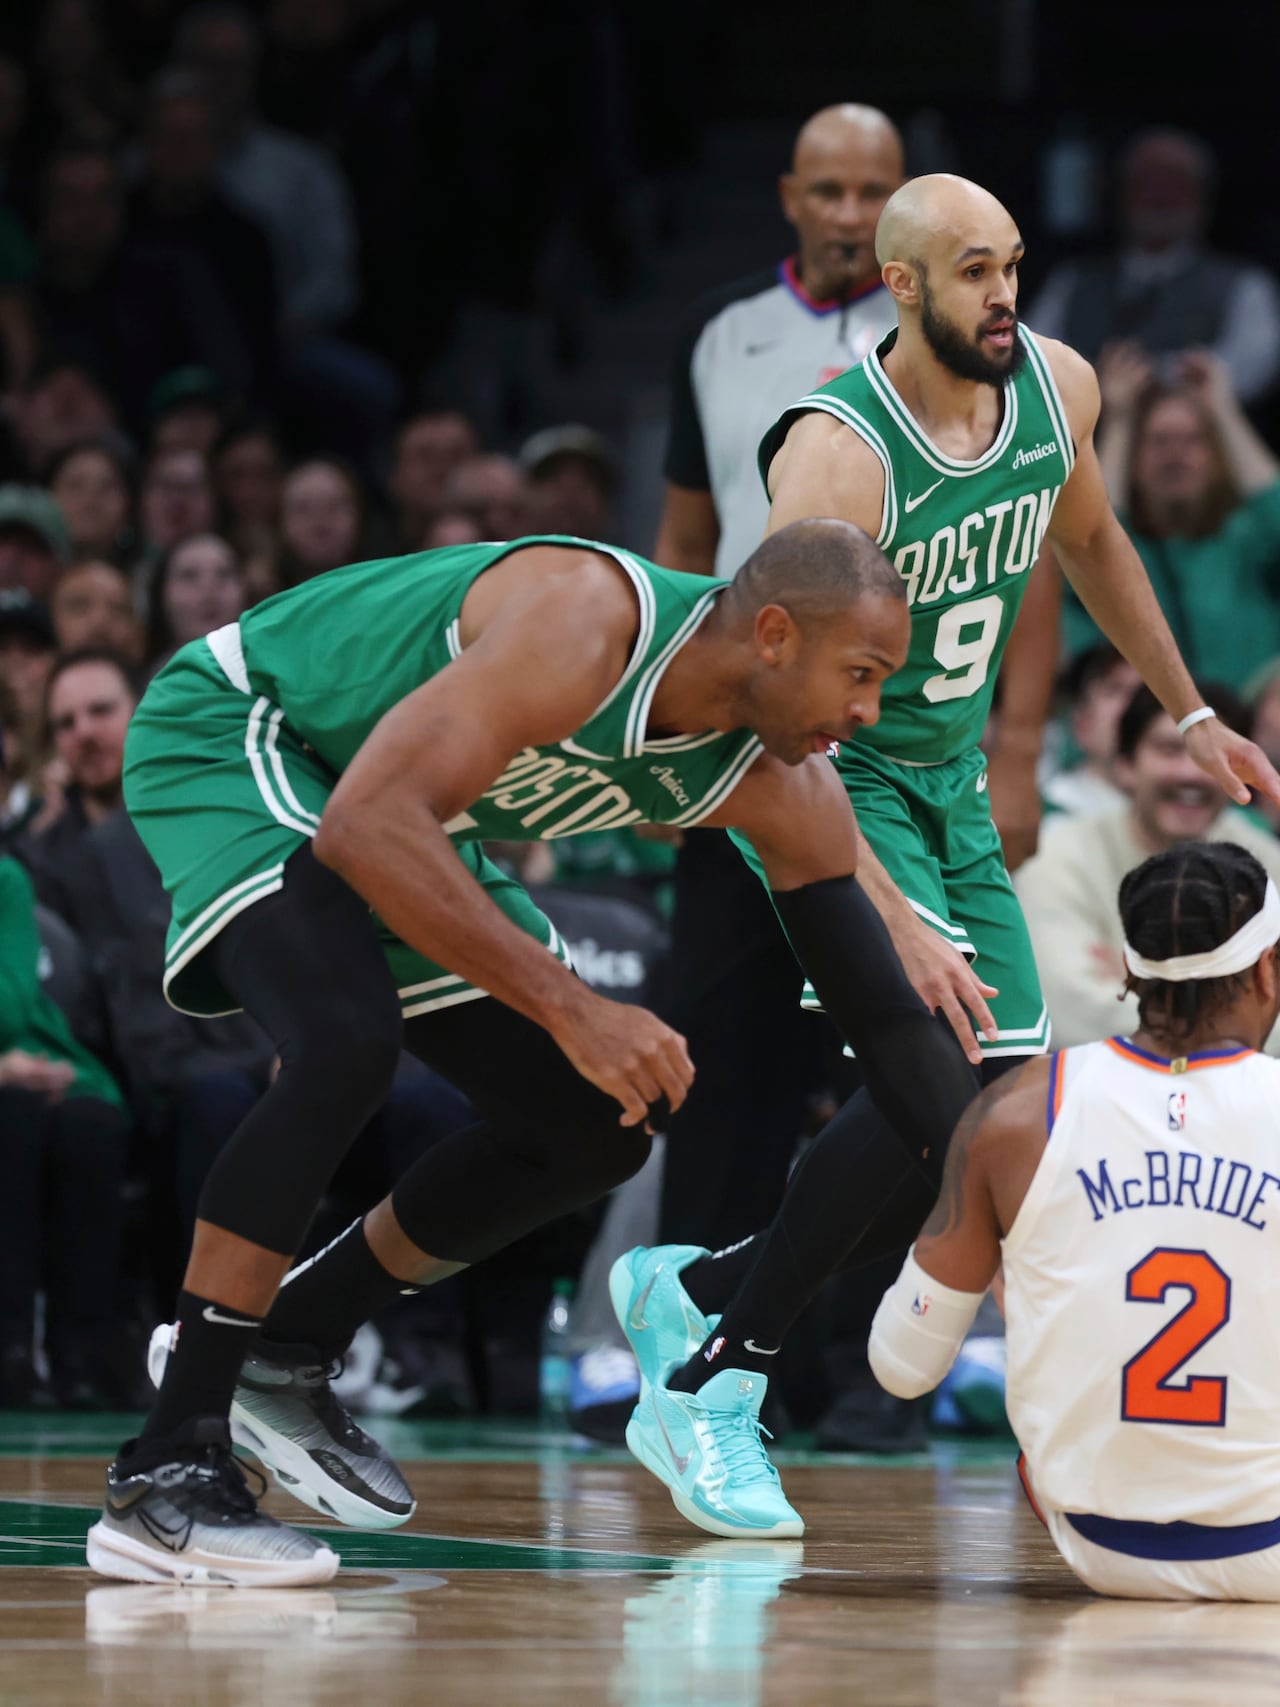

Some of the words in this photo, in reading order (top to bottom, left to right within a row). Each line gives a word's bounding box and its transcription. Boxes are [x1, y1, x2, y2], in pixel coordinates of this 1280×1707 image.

[1012, 441, 1058, 470] Amica
[922, 594, 1004, 704] 9
[482, 746, 650, 840] OSTO
[649, 766, 690, 807] Amica
[1120, 1246, 1232, 1428] 2
